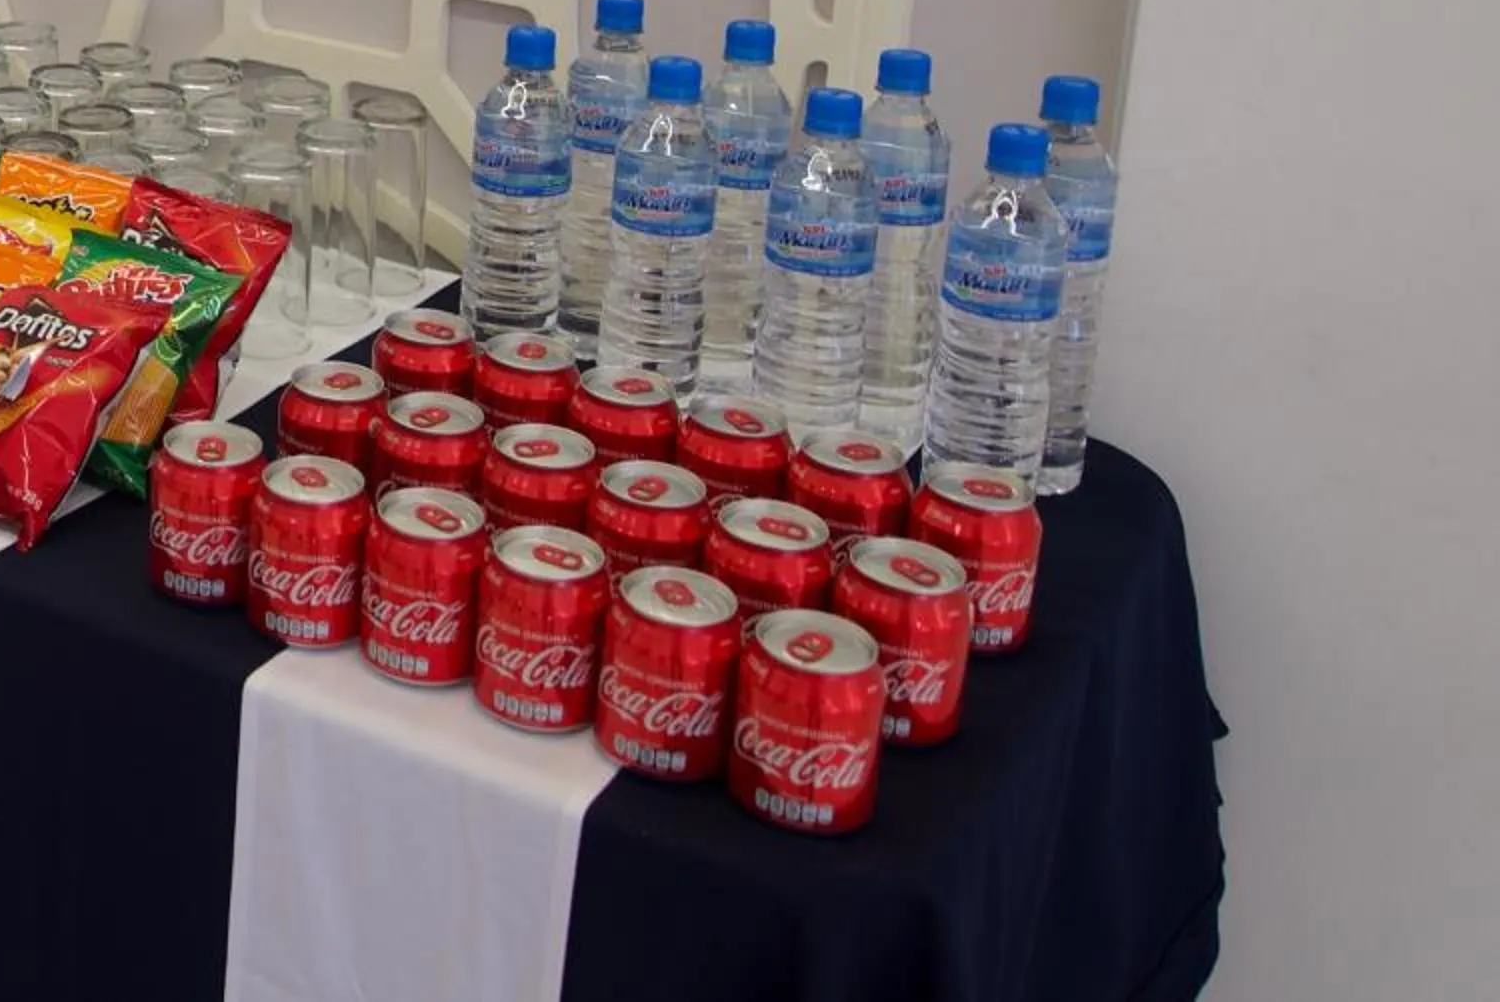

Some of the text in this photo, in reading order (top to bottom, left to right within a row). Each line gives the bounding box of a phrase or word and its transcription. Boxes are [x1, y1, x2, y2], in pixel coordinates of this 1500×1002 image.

[248, 550, 357, 606] Coca-Cola
[476, 625, 596, 690] Coca-Cola
[599, 664, 726, 737] Coca-Cola
[734, 718, 871, 789] Coca-Cola
